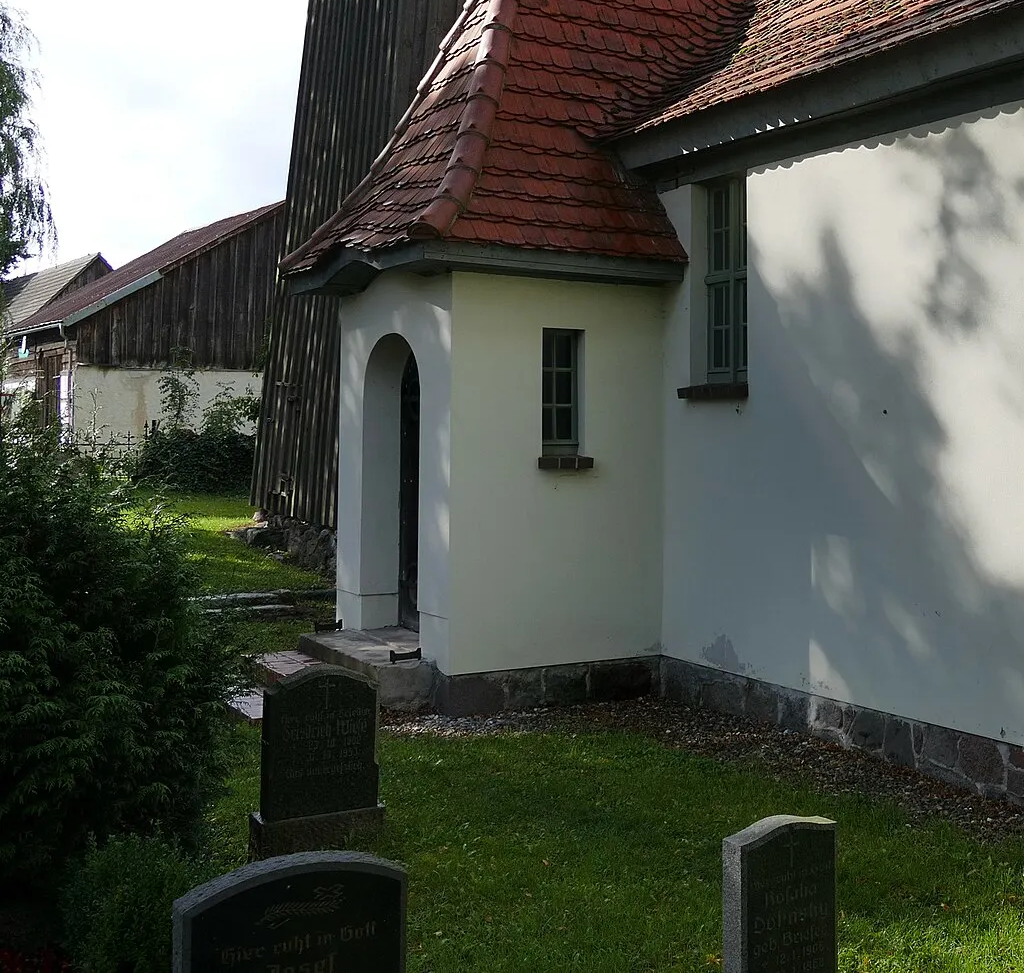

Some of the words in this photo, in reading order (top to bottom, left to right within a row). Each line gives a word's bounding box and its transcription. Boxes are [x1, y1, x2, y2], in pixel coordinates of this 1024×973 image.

[221, 945, 266, 967] Hier
[273, 932, 313, 955] ruht
[340, 919, 378, 942] Gott
